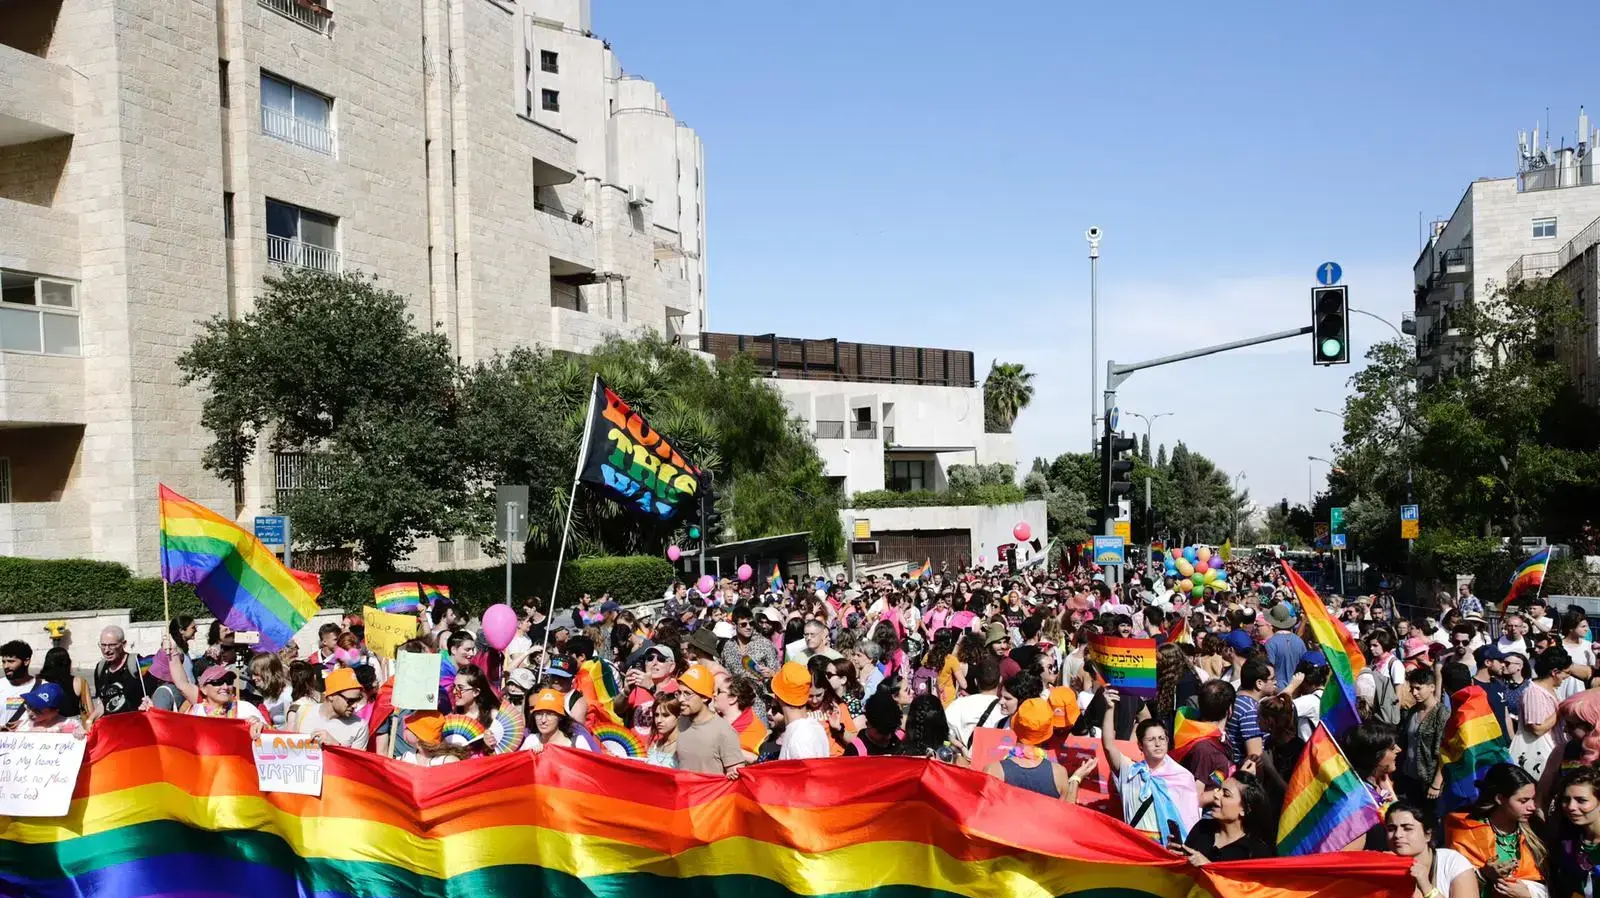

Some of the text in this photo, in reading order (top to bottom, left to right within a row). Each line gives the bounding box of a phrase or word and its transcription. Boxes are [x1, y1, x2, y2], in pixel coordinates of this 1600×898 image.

[18, 736, 34, 750] has
[54, 741, 75, 754] right
[254, 736, 321, 761] LOVE
[0, 752, 61, 770] To My heart
[13, 770, 28, 783] has
[32, 775, 44, 784] no
